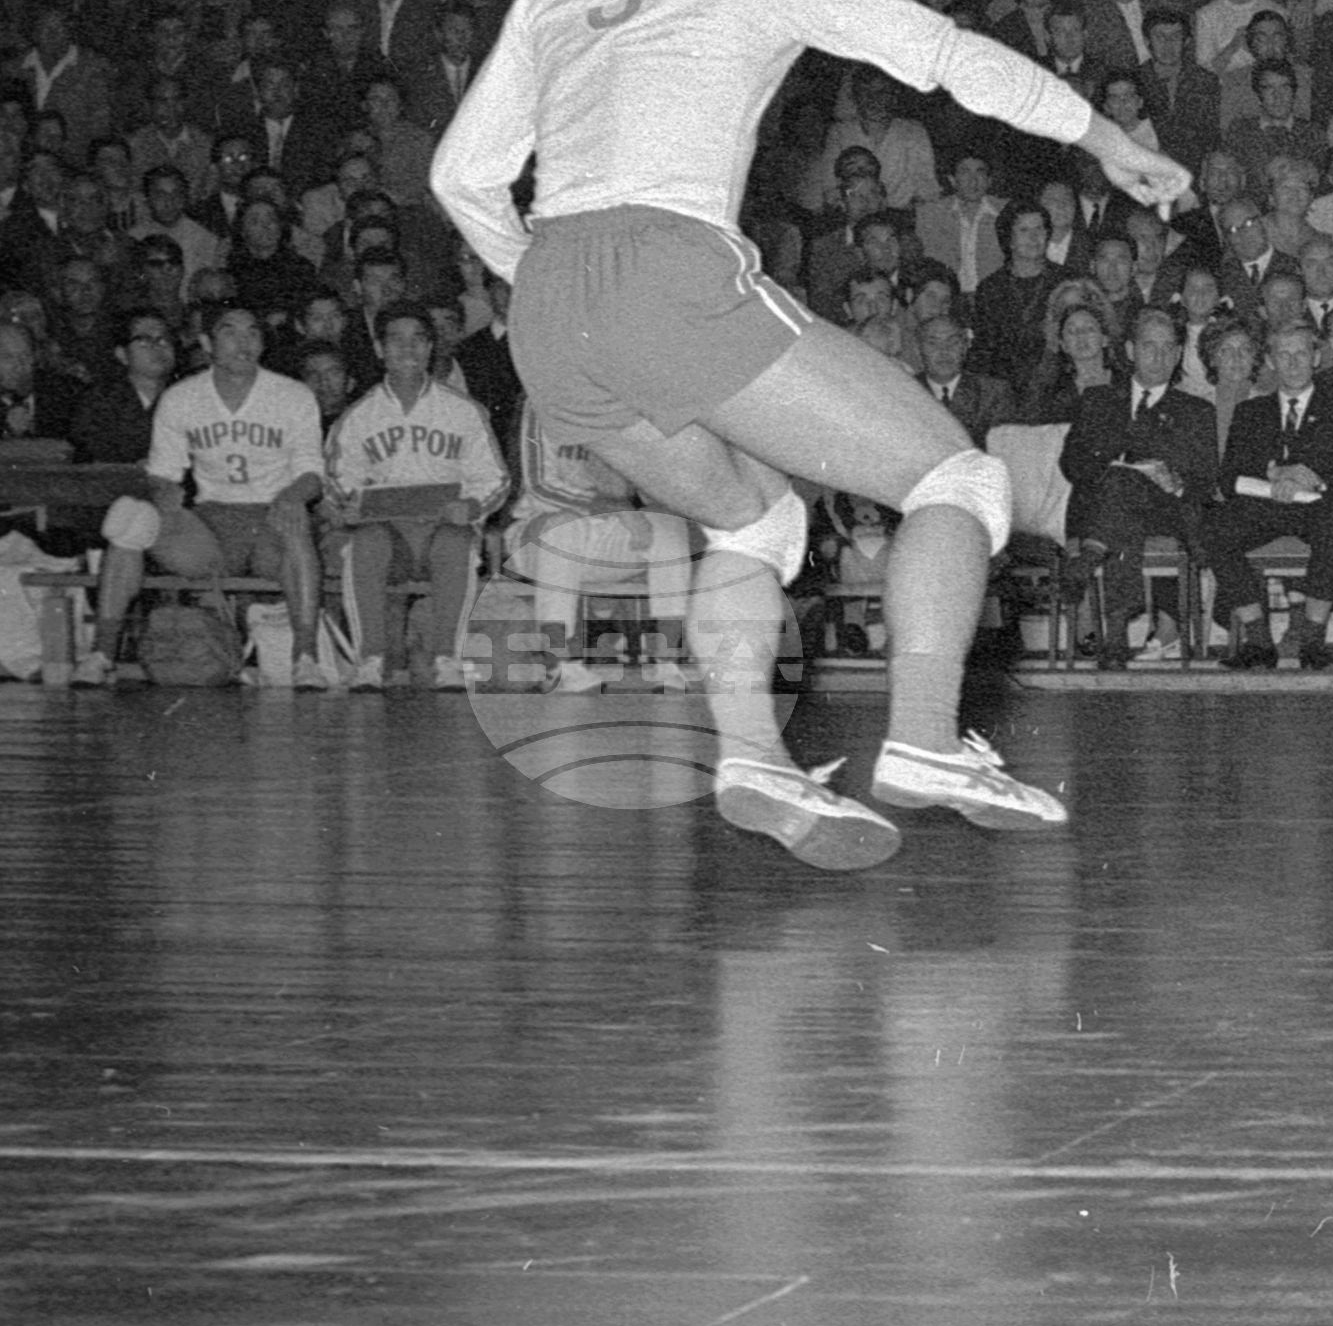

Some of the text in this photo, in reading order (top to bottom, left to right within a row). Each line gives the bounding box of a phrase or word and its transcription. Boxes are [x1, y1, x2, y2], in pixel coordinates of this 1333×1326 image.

[185, 419, 284, 451] NIPPON
[360, 424, 464, 465] NIPPON
[225, 452, 250, 485] 3
